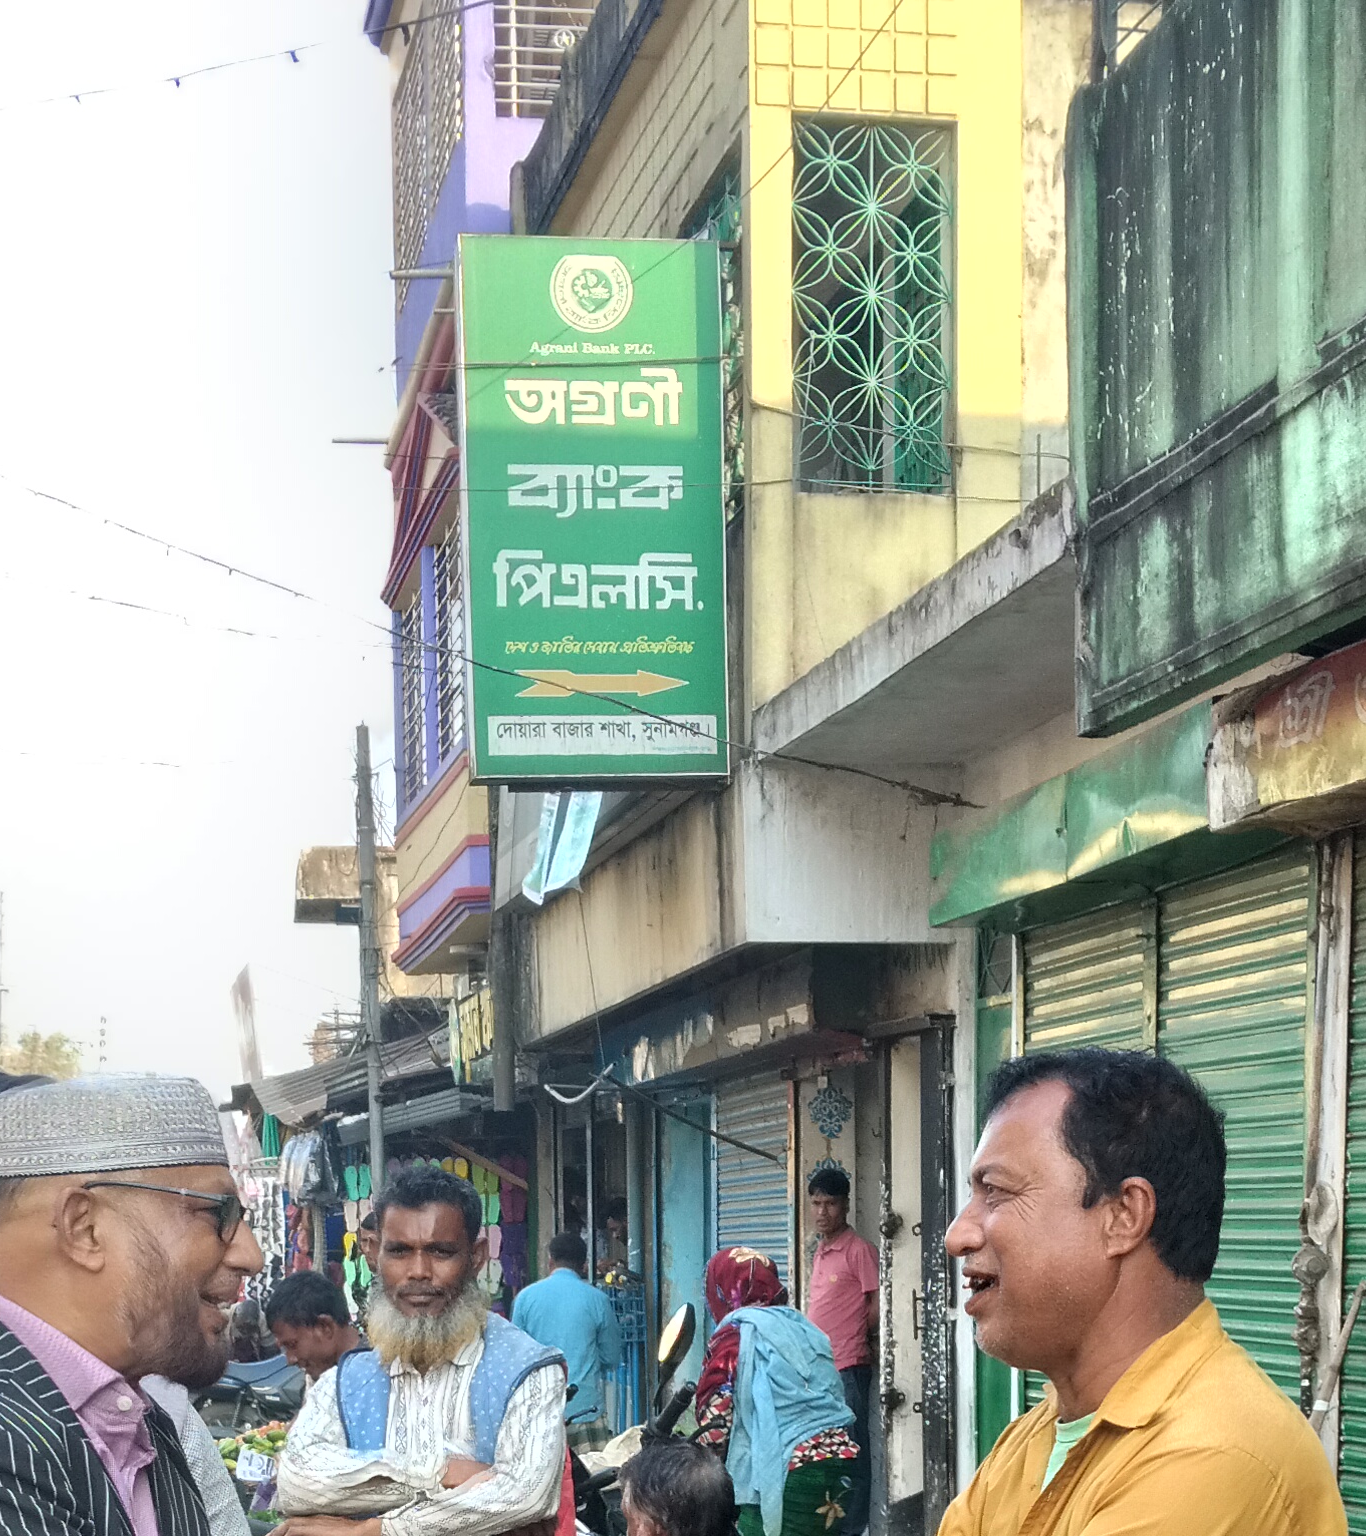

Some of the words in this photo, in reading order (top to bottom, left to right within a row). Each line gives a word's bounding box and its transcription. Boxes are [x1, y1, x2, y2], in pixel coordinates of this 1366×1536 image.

[529, 341, 578, 356] Agrani
[582, 342, 620, 354] Bank
[624, 343, 656, 355] PLC.
[504, 367, 682, 426] অগ্রণী
[506, 463, 684, 519] ব্যাংক
[492, 549, 704, 612] পিএলসি.
[496, 721, 546, 739] দোয়ারা
[552, 721, 594, 739] বাজার
[600, 721, 636, 742] শাখা,
